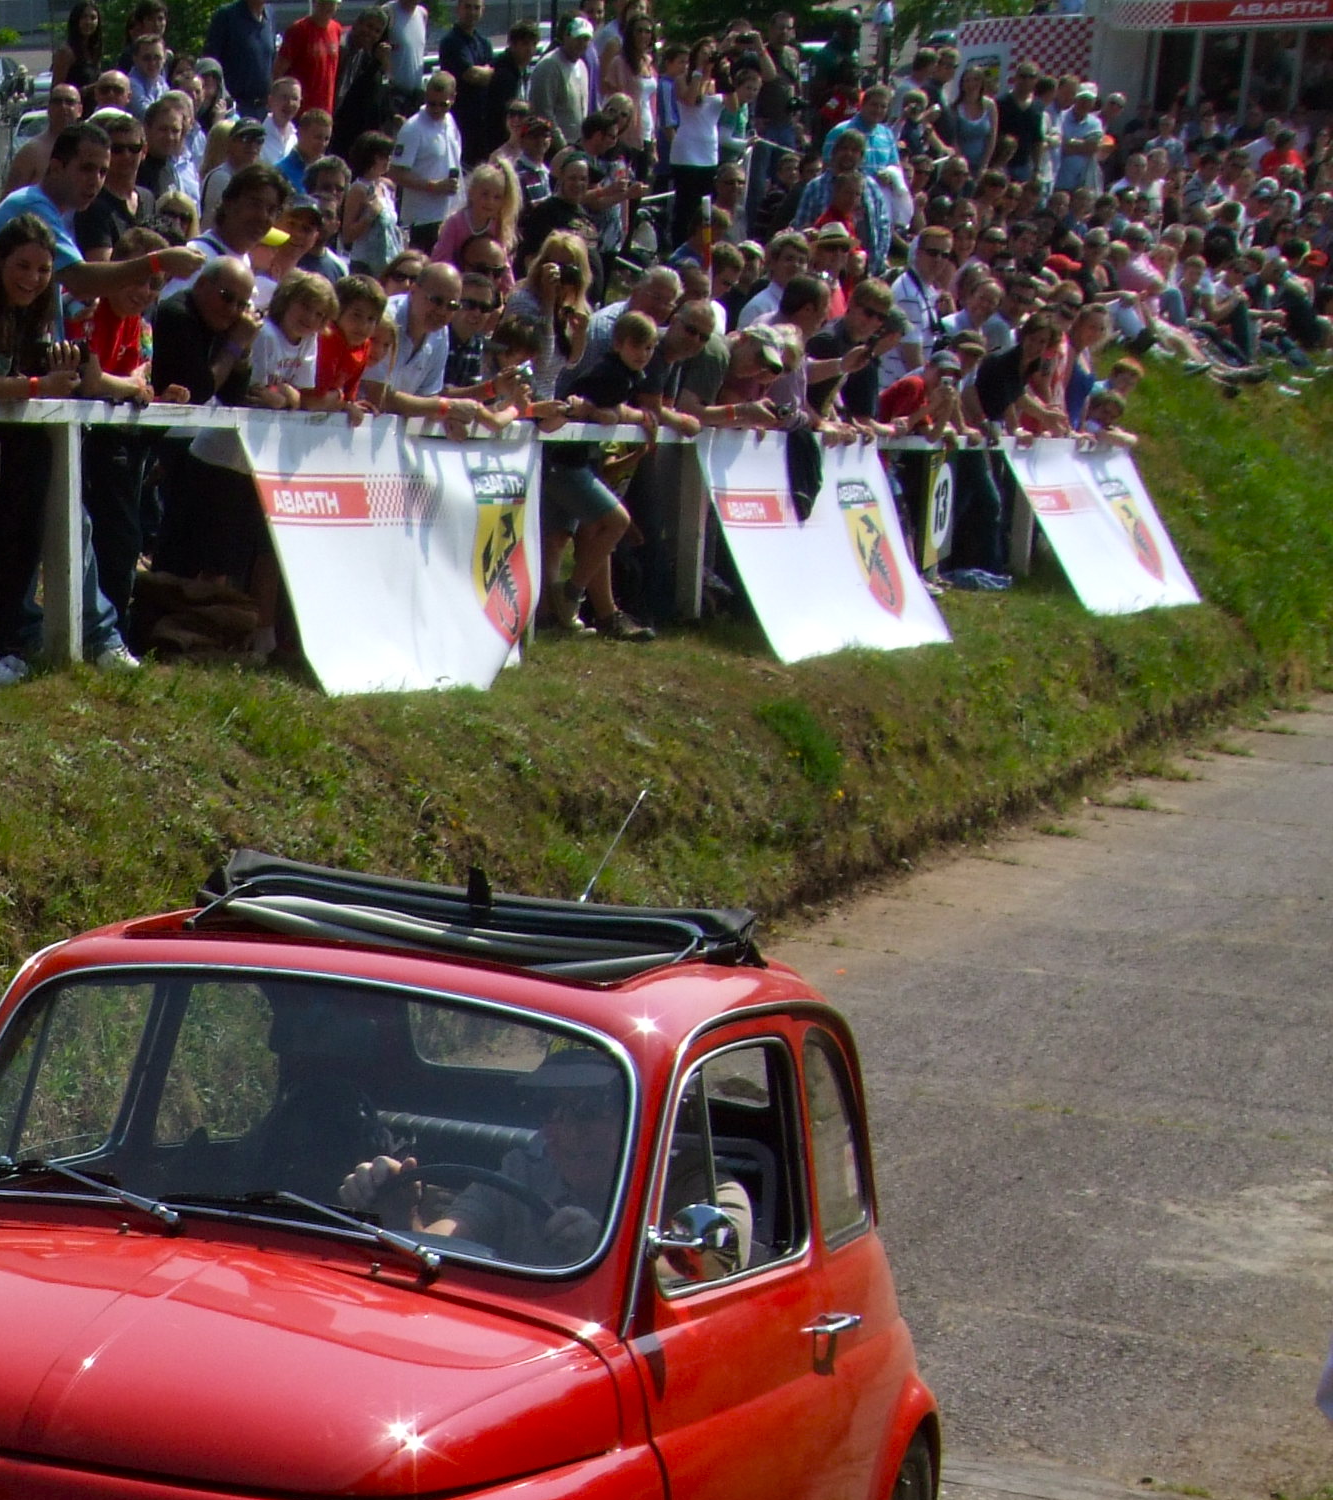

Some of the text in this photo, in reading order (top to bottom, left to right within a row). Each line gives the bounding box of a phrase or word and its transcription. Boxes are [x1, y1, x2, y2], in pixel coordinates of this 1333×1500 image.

[1229, 1, 1329, 16] ABARTH
[272, 489, 341, 515] ABARTH
[933, 478, 949, 535] 13
